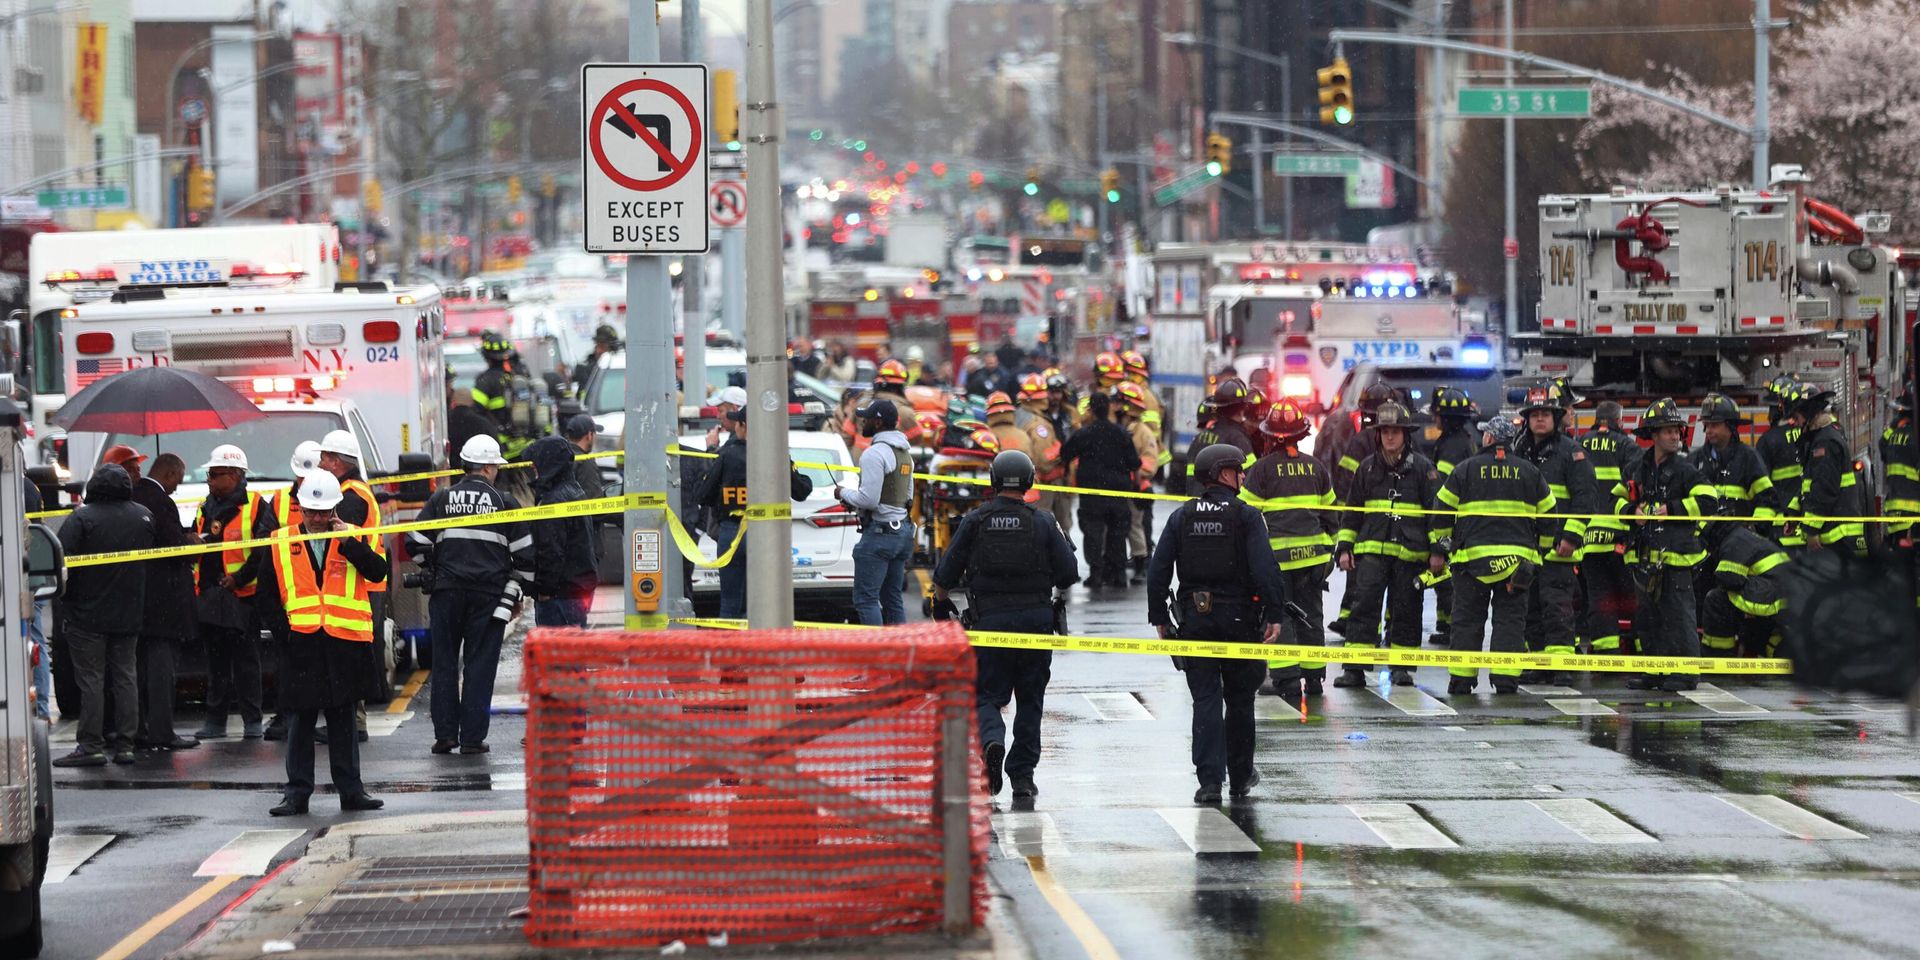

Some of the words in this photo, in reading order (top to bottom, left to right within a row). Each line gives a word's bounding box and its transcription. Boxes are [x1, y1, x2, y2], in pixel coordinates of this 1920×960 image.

[1490, 92, 1521, 112] 35
[1532, 92, 1557, 112] St
[608, 201, 684, 218] EXCEPT
[613, 225, 679, 242] BUSES
[141, 260, 209, 271] NYPD
[1549, 245, 1575, 286] 114
[1744, 240, 1778, 282] 114
[130, 271, 222, 284] POLICE
[1623, 303, 1664, 322] TALLY
[1667, 303, 1687, 321] HO
[366, 346, 399, 363] 024
[1353, 342, 1420, 356] NYPD
[1480, 465, 1520, 480] F.D.N.Y.
[449, 490, 493, 506] MTA
[722, 487, 748, 505] FB
[445, 503, 473, 514] PHOTO
[475, 505, 498, 514] UNIT
[991, 517, 1020, 528] NYPD
[1193, 522, 1223, 533] NYPD
[1290, 545, 1316, 561] GONG
[1489, 555, 1517, 573] SMITH
